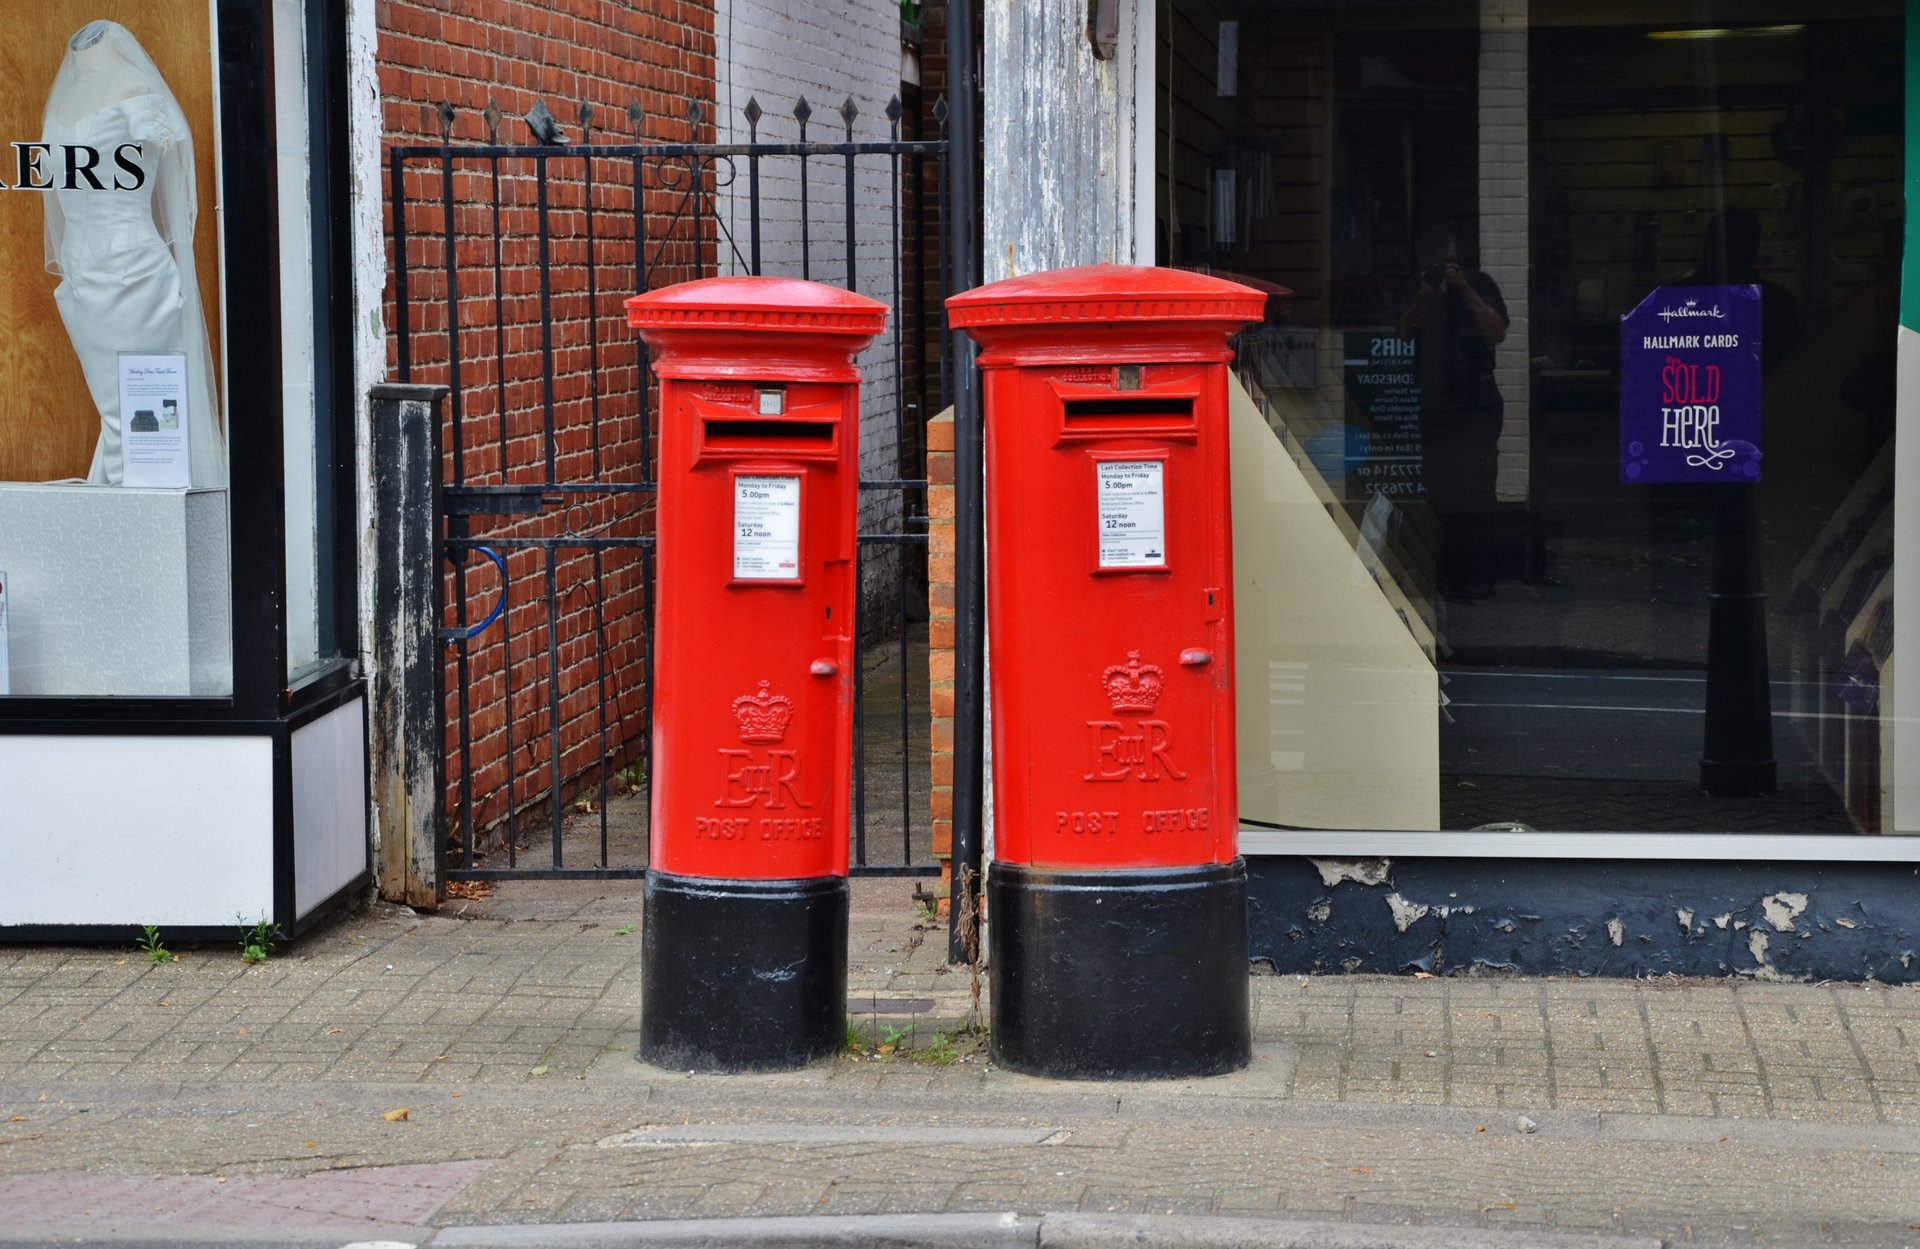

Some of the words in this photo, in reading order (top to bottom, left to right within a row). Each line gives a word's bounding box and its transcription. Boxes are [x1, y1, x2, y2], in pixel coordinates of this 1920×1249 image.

[0, 142, 145, 191] ERS
[1657, 304, 1726, 323] Hallmark
[1643, 336, 1700, 349] HALLMARK
[1704, 335, 1738, 347] CARDS
[1661, 355, 1720, 404] SOLD
[768, 482, 786, 490] Friday
[1105, 480, 1133, 489] 5.00pm
[742, 489, 770, 499] 5.00pm
[1105, 519, 1117, 528] 12
[741, 528, 752, 537] 12
[1055, 811, 1119, 834] POST
[1141, 807, 1209, 833] OFFICE
[695, 816, 750, 840] POST
[760, 817, 823, 841] OFFICE
